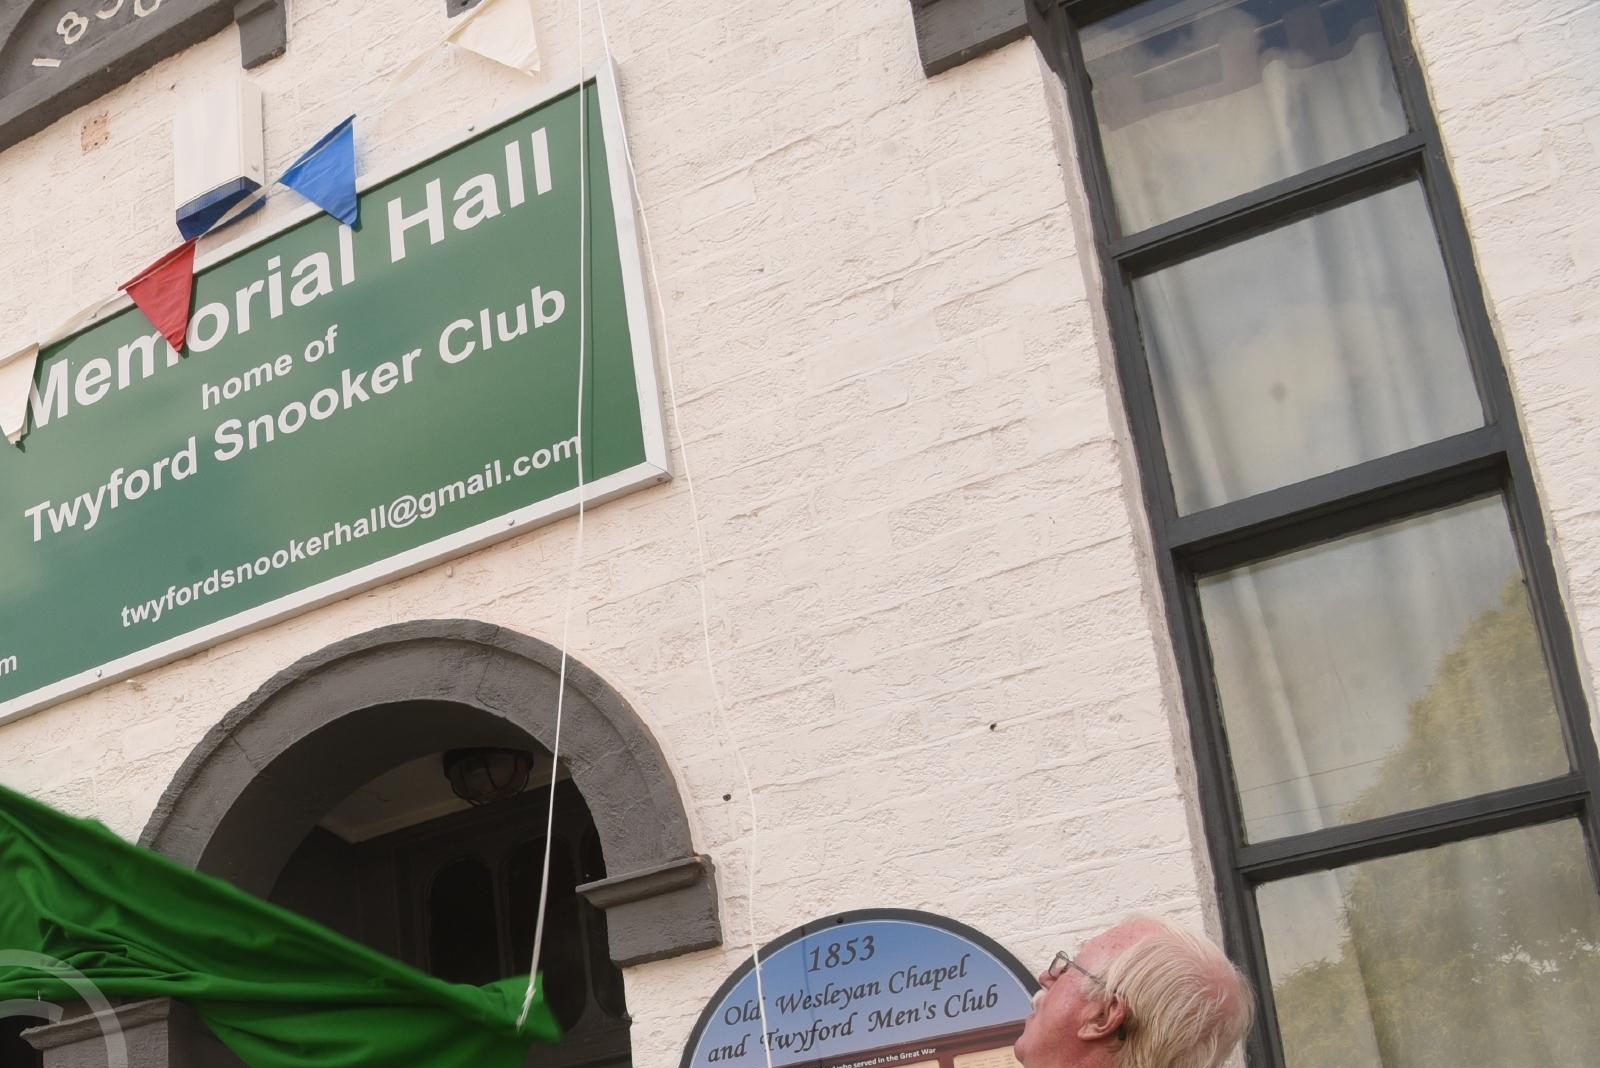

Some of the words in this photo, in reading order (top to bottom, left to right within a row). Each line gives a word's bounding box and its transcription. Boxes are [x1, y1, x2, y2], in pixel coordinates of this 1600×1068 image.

[28, 224, 355, 429] Memorial
[388, 127, 552, 263] Hall
[202, 353, 293, 410] home
[304, 324, 338, 364] of
[24, 436, 197, 542] Twyford
[214, 348, 422, 461] Snooker
[439, 285, 566, 364] Club
[121, 433, 582, 628] twyfordsnookerhall@gmail.com
[724, 996, 766, 1026] Old
[775, 980, 881, 1015] Wesleyan
[888, 953, 971, 994] Chapel
[807, 935, 875, 973] 1853
[708, 1034, 750, 1063] and
[760, 1012, 858, 1053] Twyford
[868, 1001, 936, 1032] Men's
[944, 984, 998, 1018] Club
[854, 1059, 877, 1068] served
[878, 1056, 885, 1064] in
[886, 1054, 899, 1062] the
[900, 1051, 920, 1060] Great
[921, 1048, 937, 1056] War
